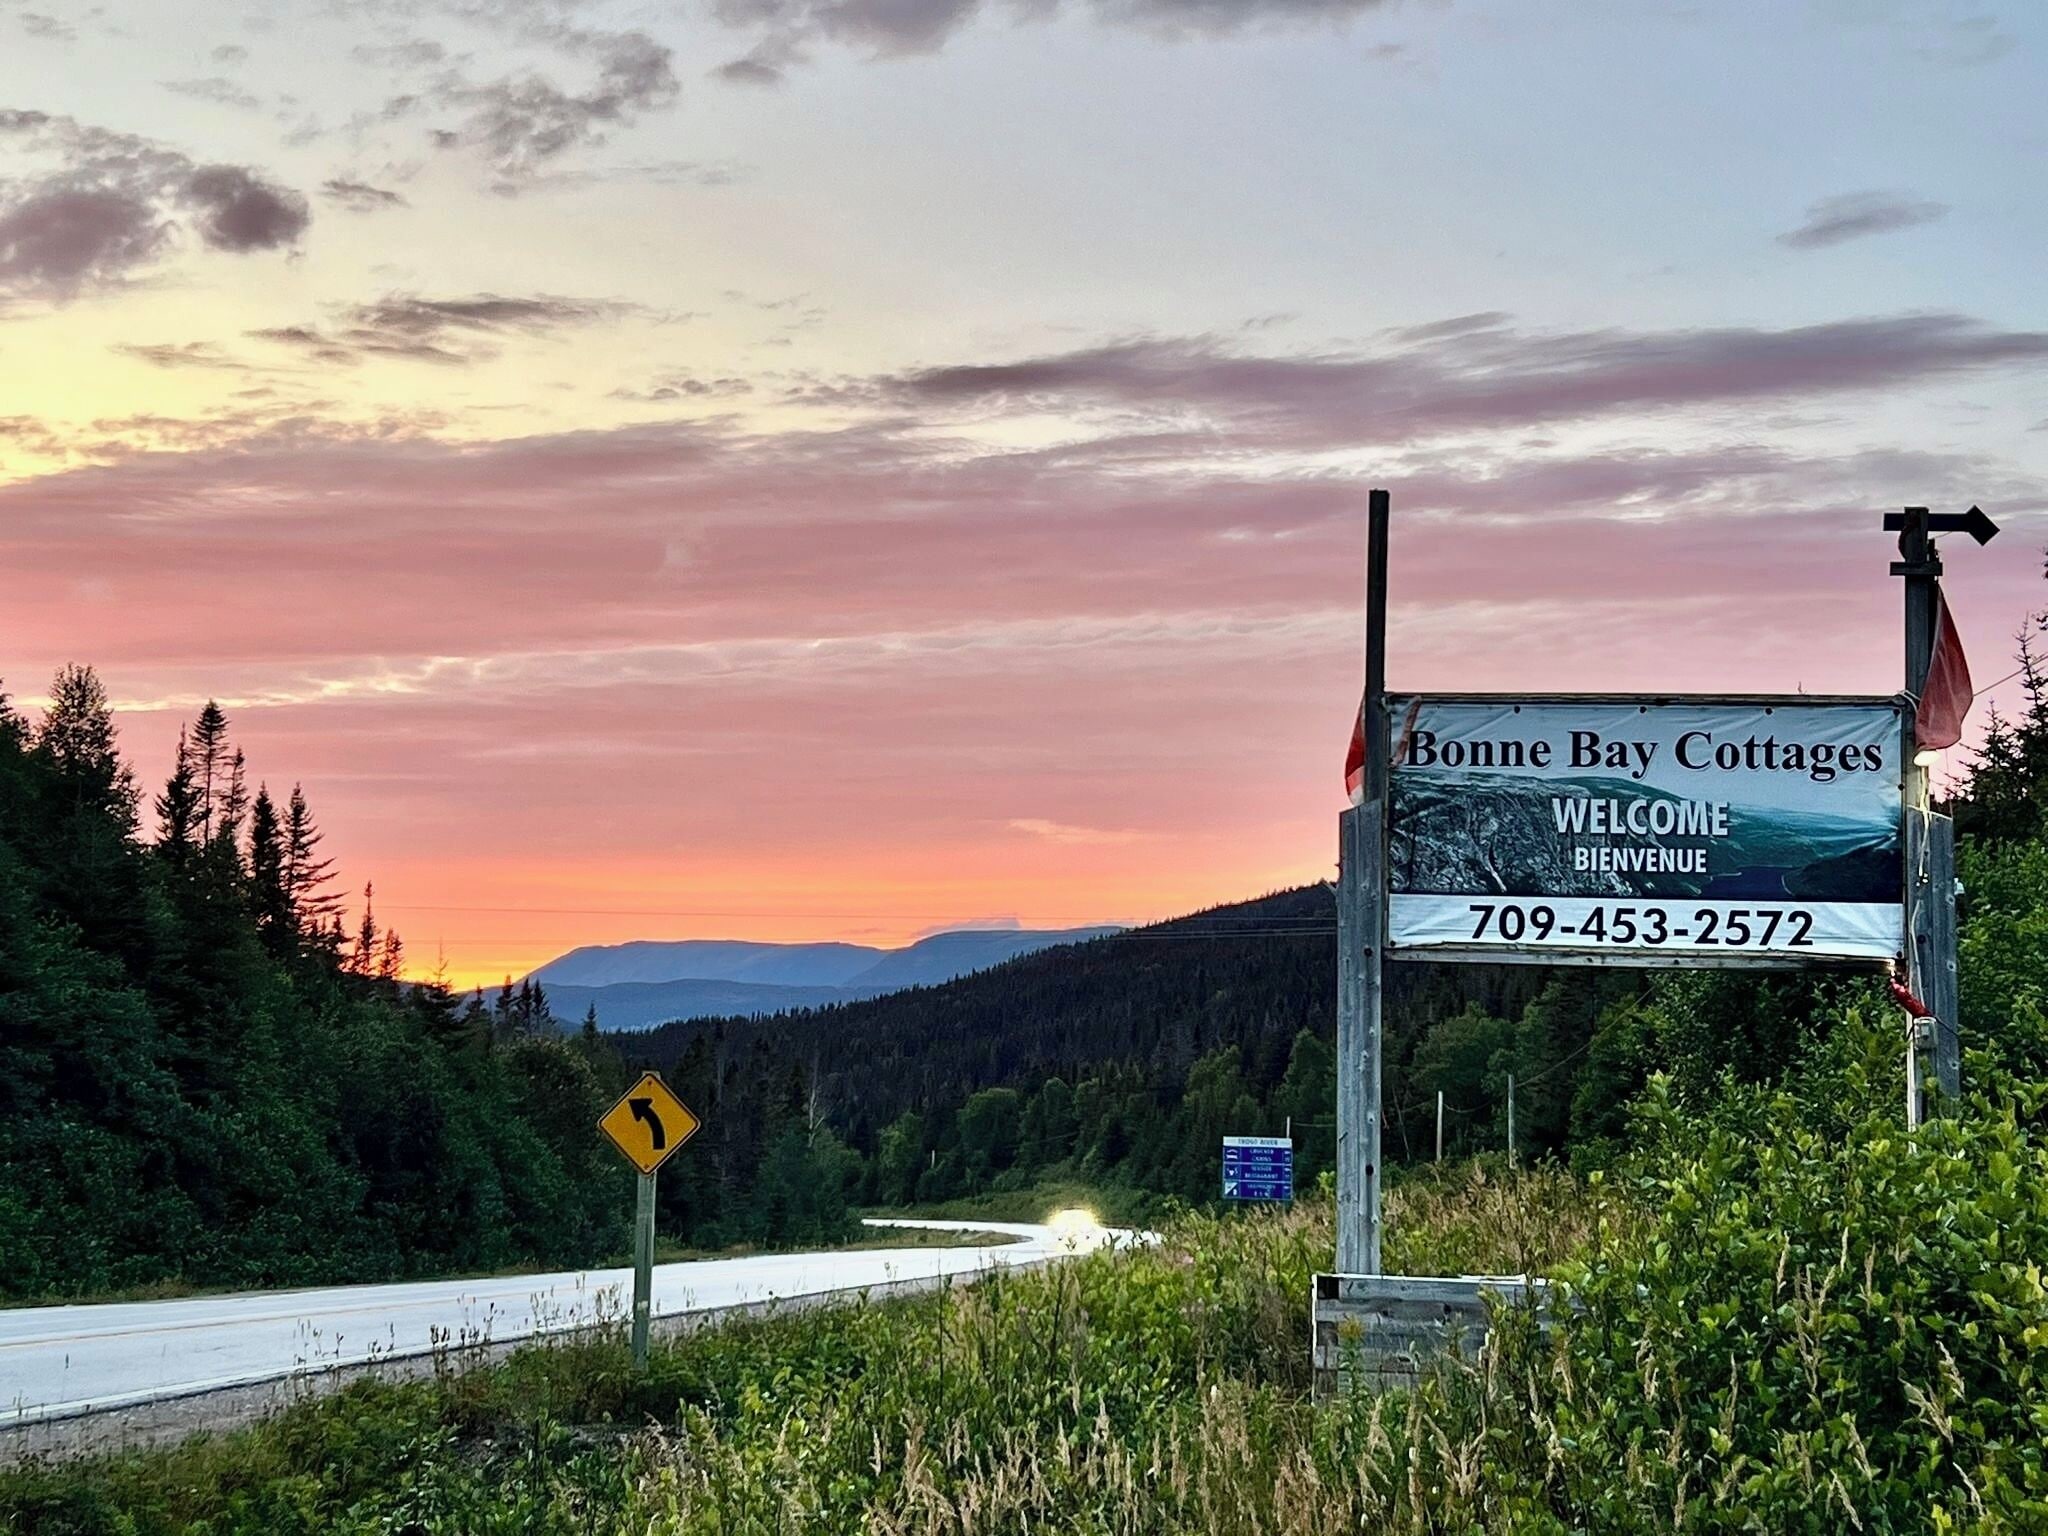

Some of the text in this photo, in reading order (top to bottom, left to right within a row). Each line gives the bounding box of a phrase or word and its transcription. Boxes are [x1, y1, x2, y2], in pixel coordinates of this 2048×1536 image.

[1408, 731, 1883, 780] Bonne Bay Cottages
[1552, 799, 1729, 836] WELCOME
[1575, 847, 1707, 873] BIENVENUE
[1469, 905, 1814, 946] 709-453-2572
